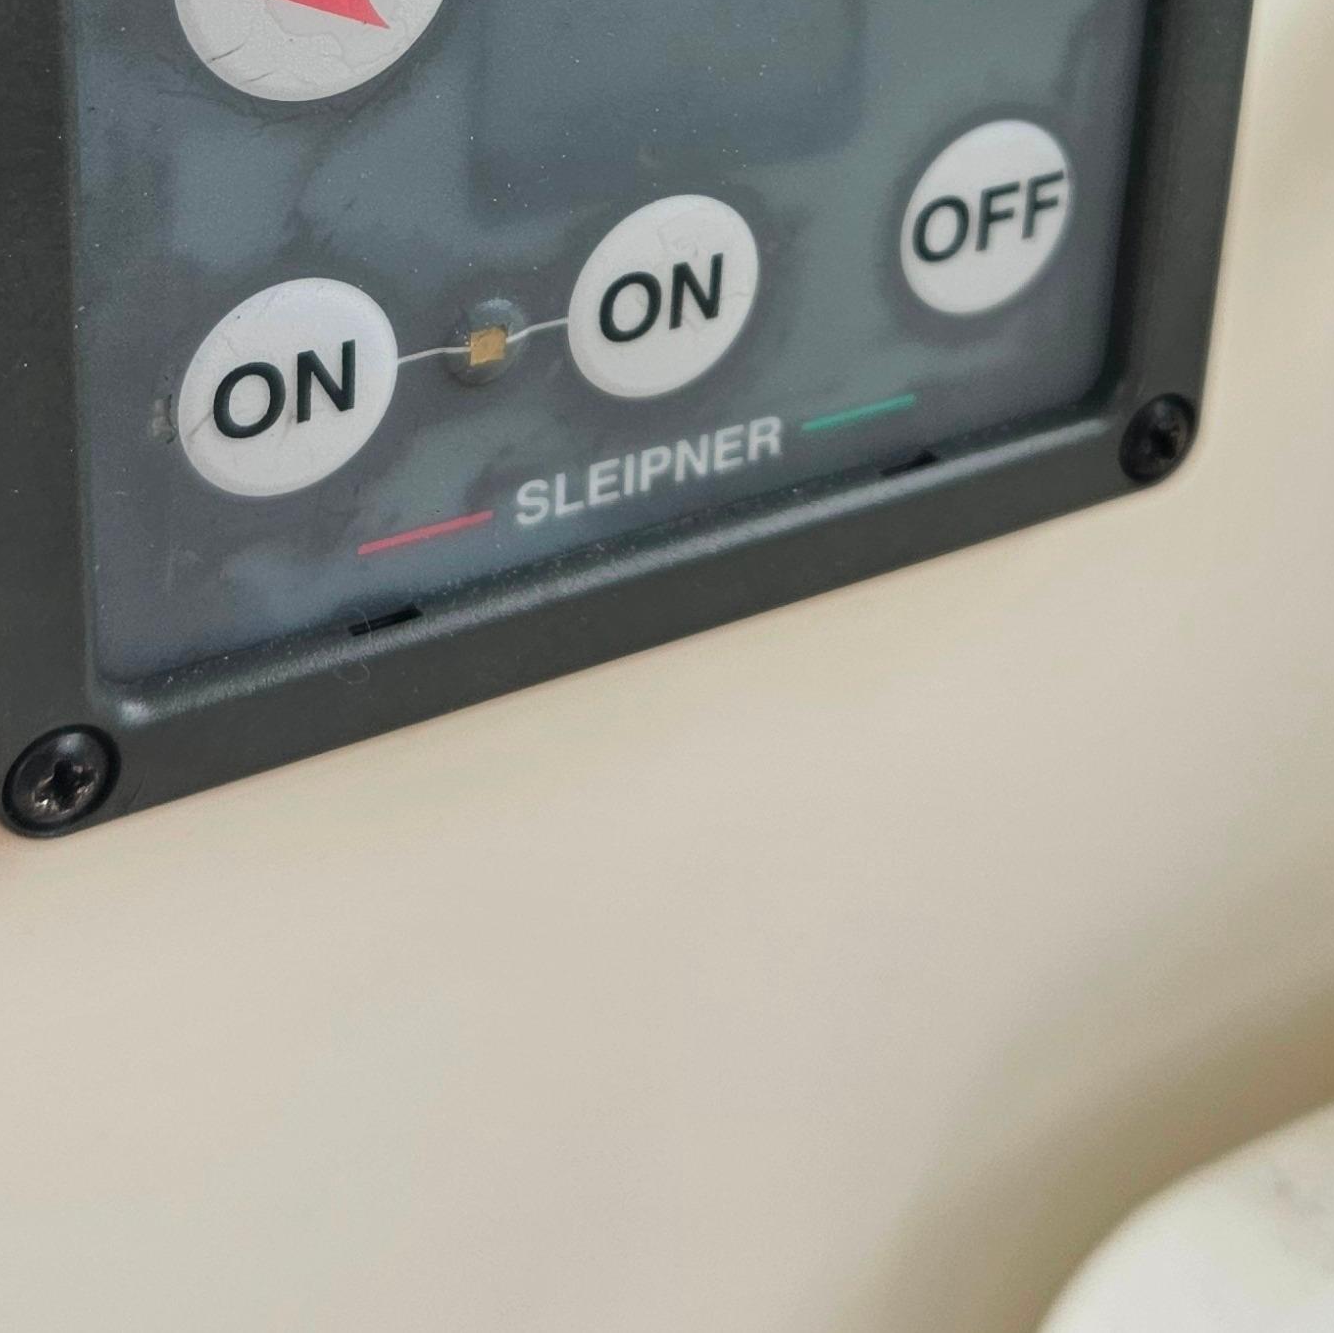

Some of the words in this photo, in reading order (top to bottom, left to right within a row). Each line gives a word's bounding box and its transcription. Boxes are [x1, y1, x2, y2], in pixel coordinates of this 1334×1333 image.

[912, 169, 1065, 264] OFF
[598, 252, 724, 343] ON
[212, 339, 357, 440] ON
[515, 416, 782, 526] SLEIPNER
